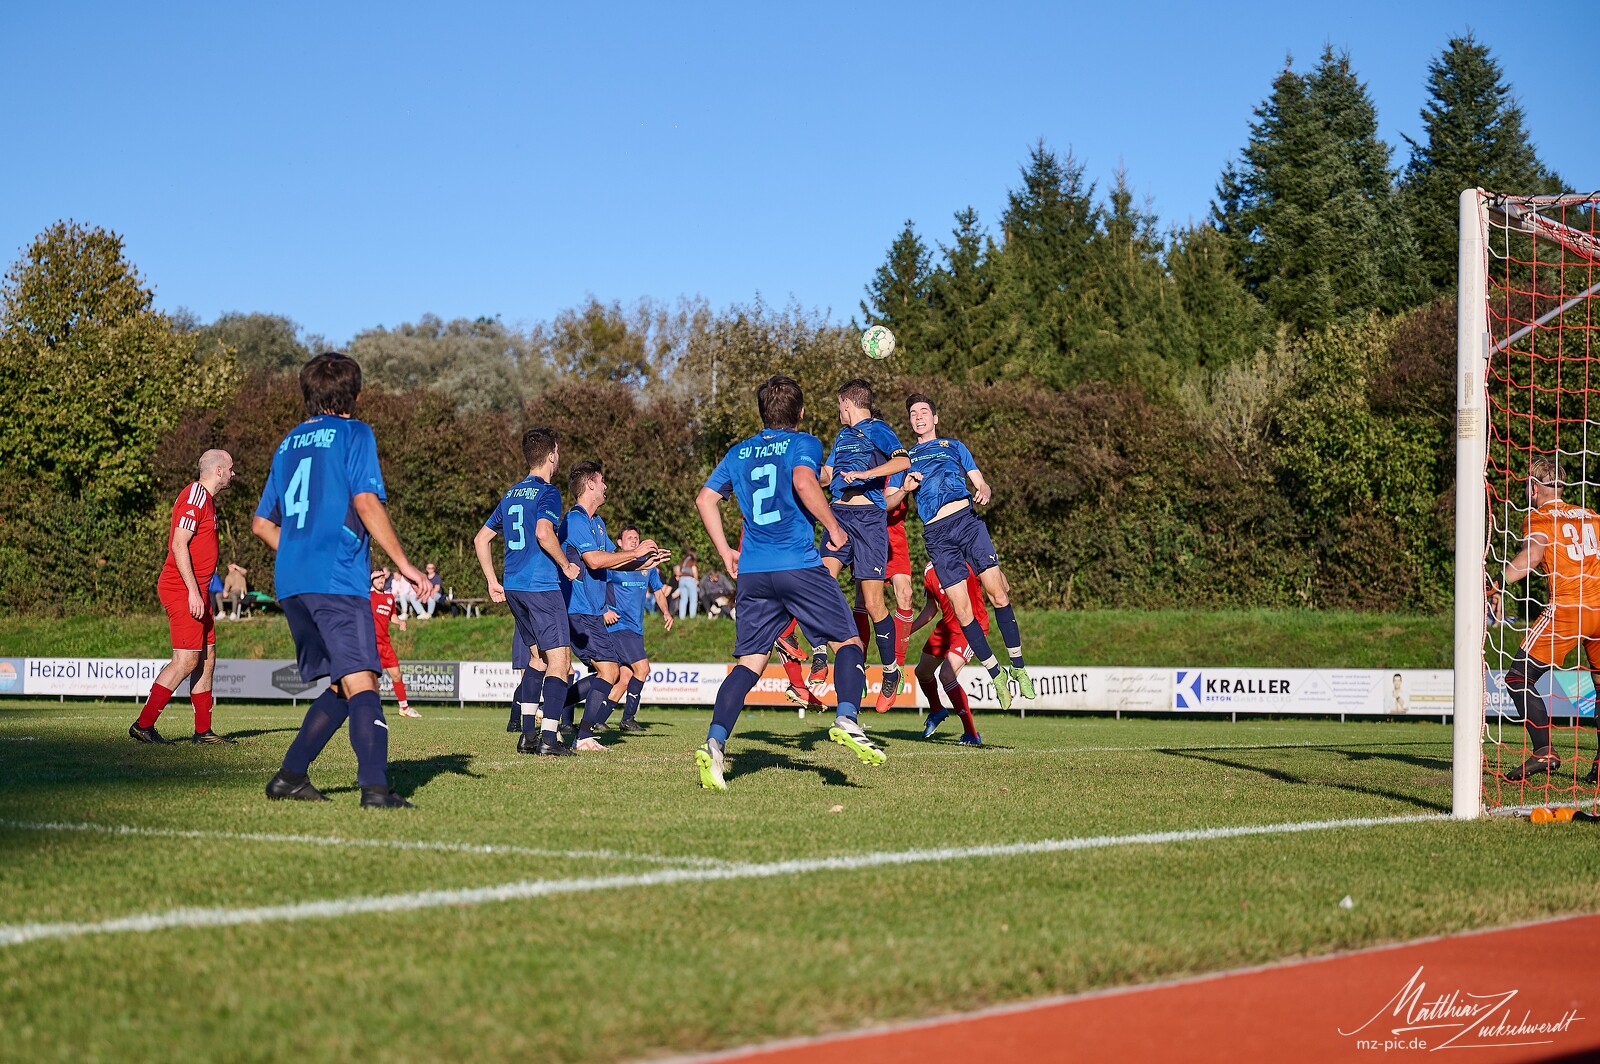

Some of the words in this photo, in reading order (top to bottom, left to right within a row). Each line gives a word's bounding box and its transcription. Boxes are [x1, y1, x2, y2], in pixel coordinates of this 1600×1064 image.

[293, 429, 336, 449] TACHING
[738, 446, 752, 459] SV
[284, 456, 312, 529] 4
[513, 487, 539, 498] TACHING
[751, 463, 782, 525] 2
[508, 504, 526, 550] 3
[30, 661, 81, 678] Heizöl
[88, 661, 155, 679] Nickolai
[400, 665, 454, 675] RSCHULE
[377, 673, 455, 684] ENELMANN
[750, 678, 789, 692] KERE
[1206, 679, 1290, 694] KRALLER
